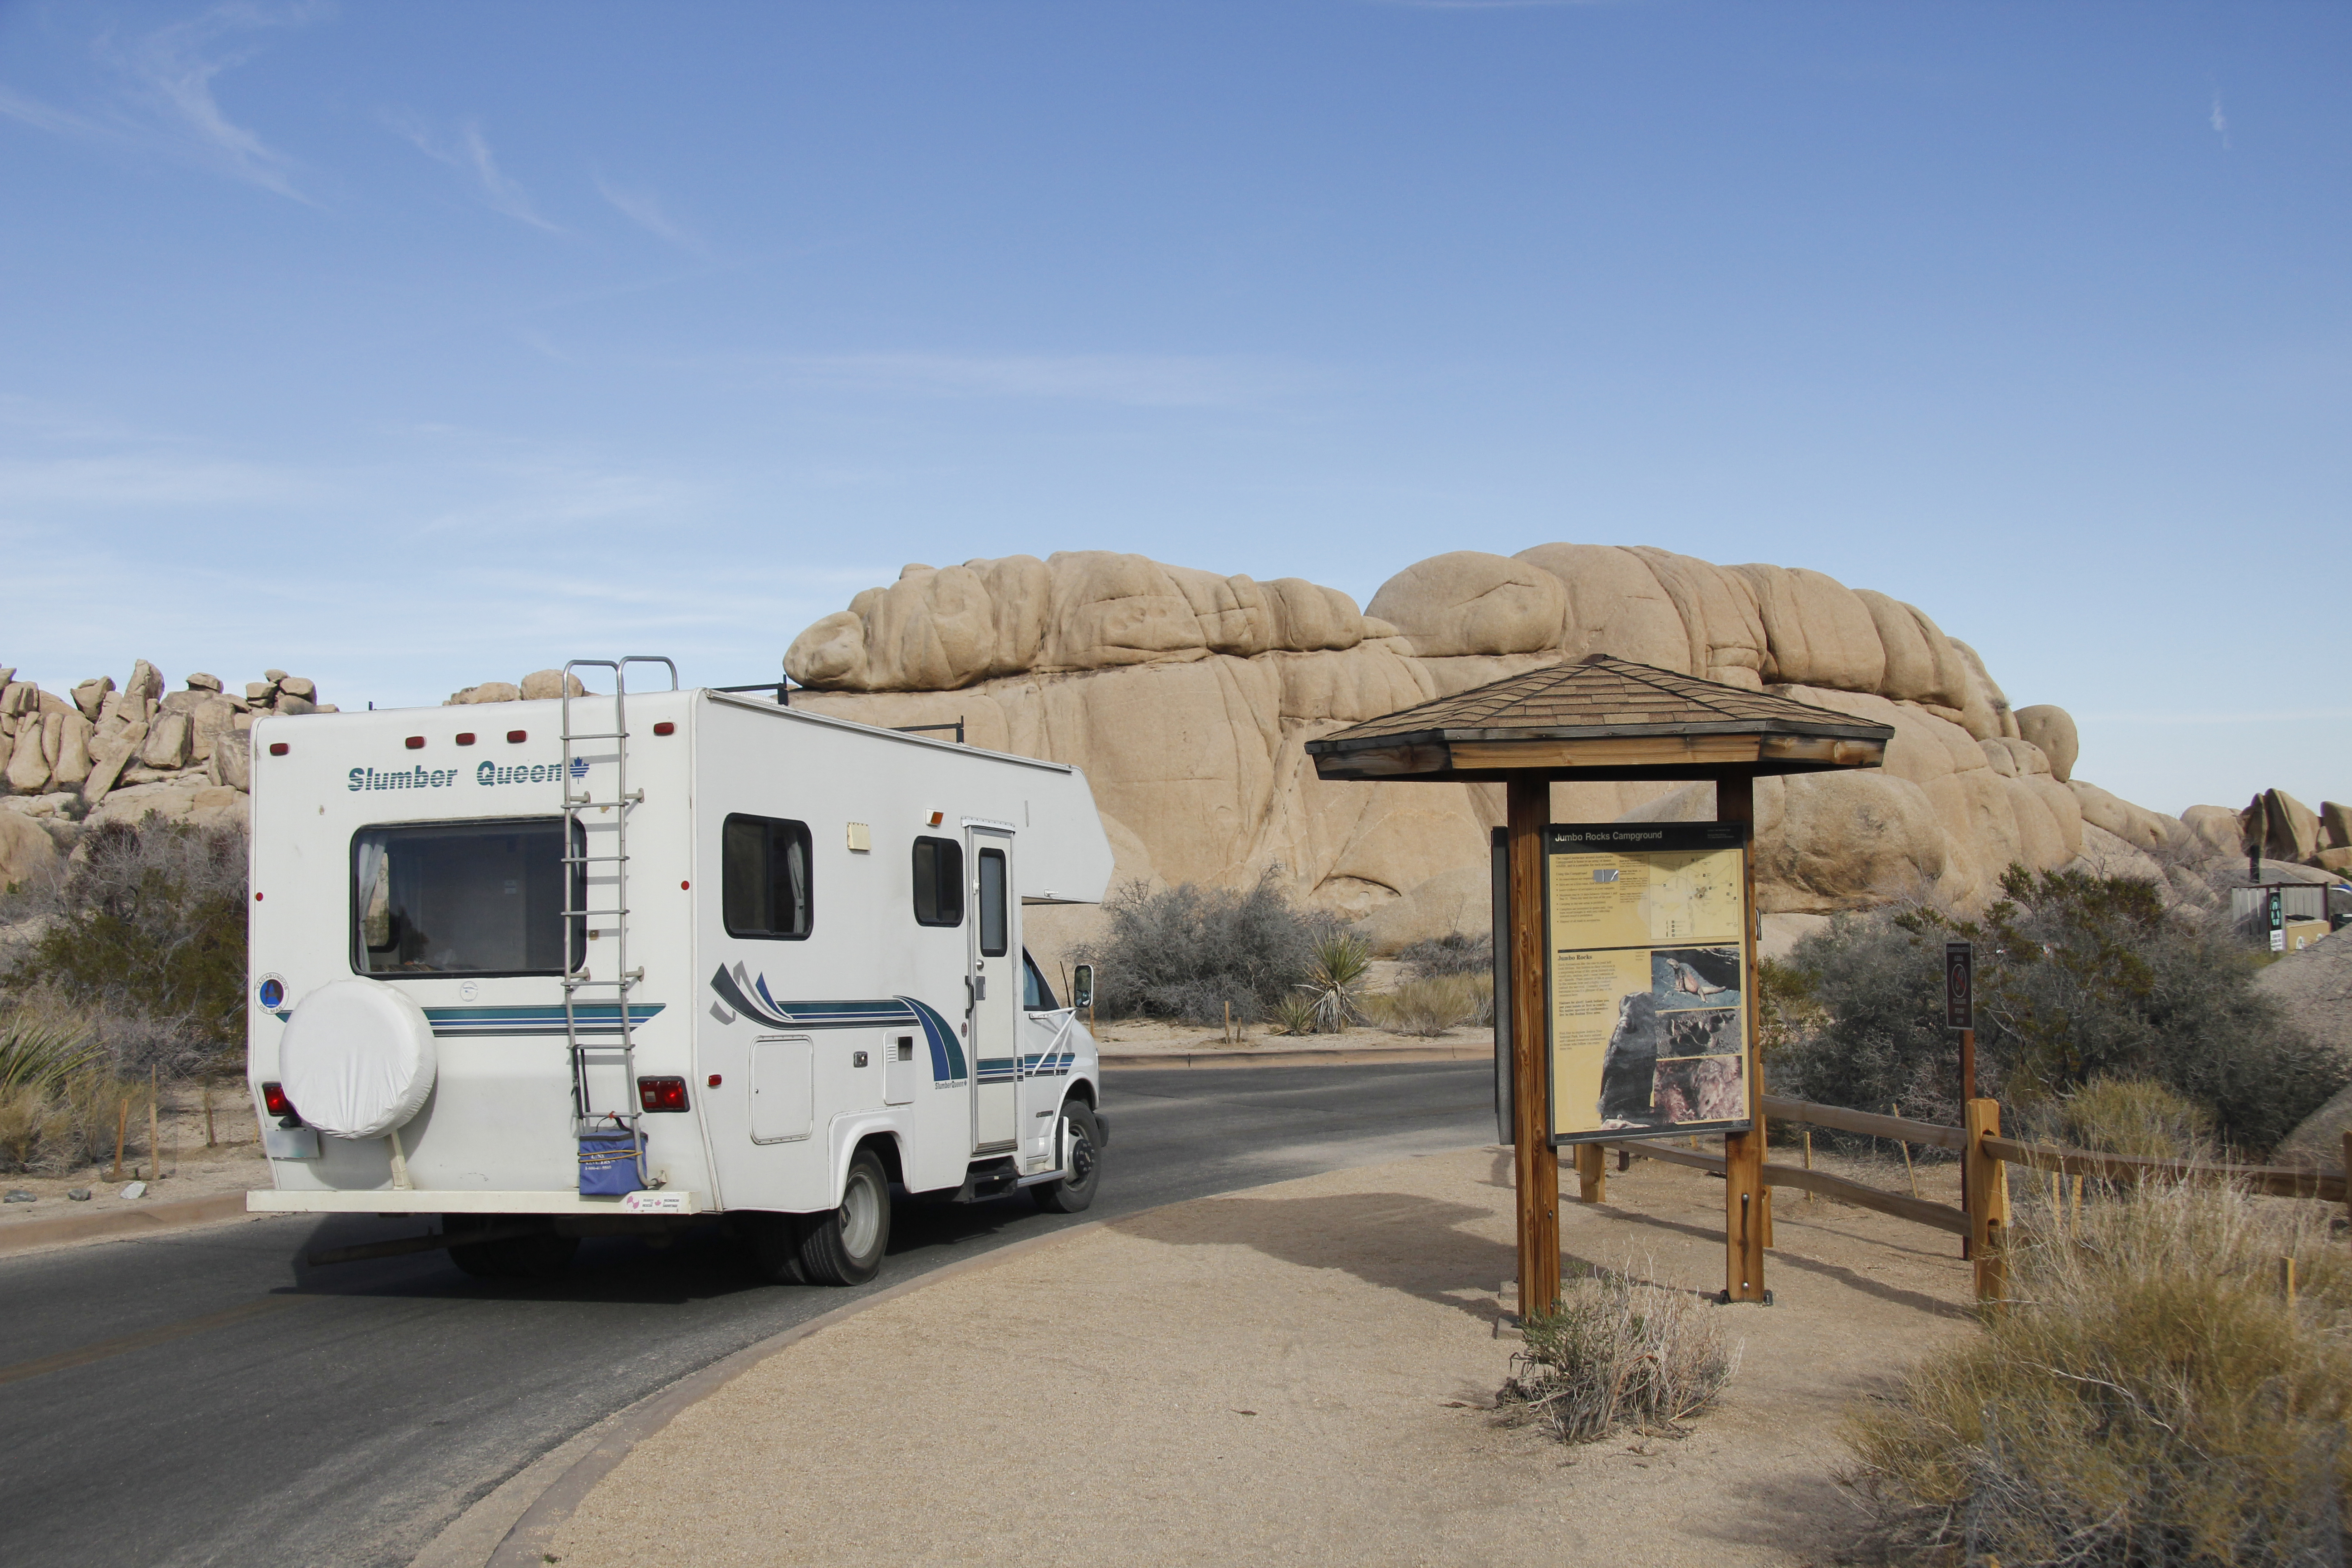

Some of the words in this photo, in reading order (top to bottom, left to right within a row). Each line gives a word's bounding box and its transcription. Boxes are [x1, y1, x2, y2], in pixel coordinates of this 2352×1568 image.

[348, 765, 458, 791] Slumber
[476, 760, 563, 787] Queen
[1555, 833, 1583, 842] Jumbo
[1585, 832, 1610, 840] Rocks
[1612, 831, 1662, 841] Campground
[256, 974, 288, 990] VAGABUNDOS
[259, 1004, 269, 1013] DEL
